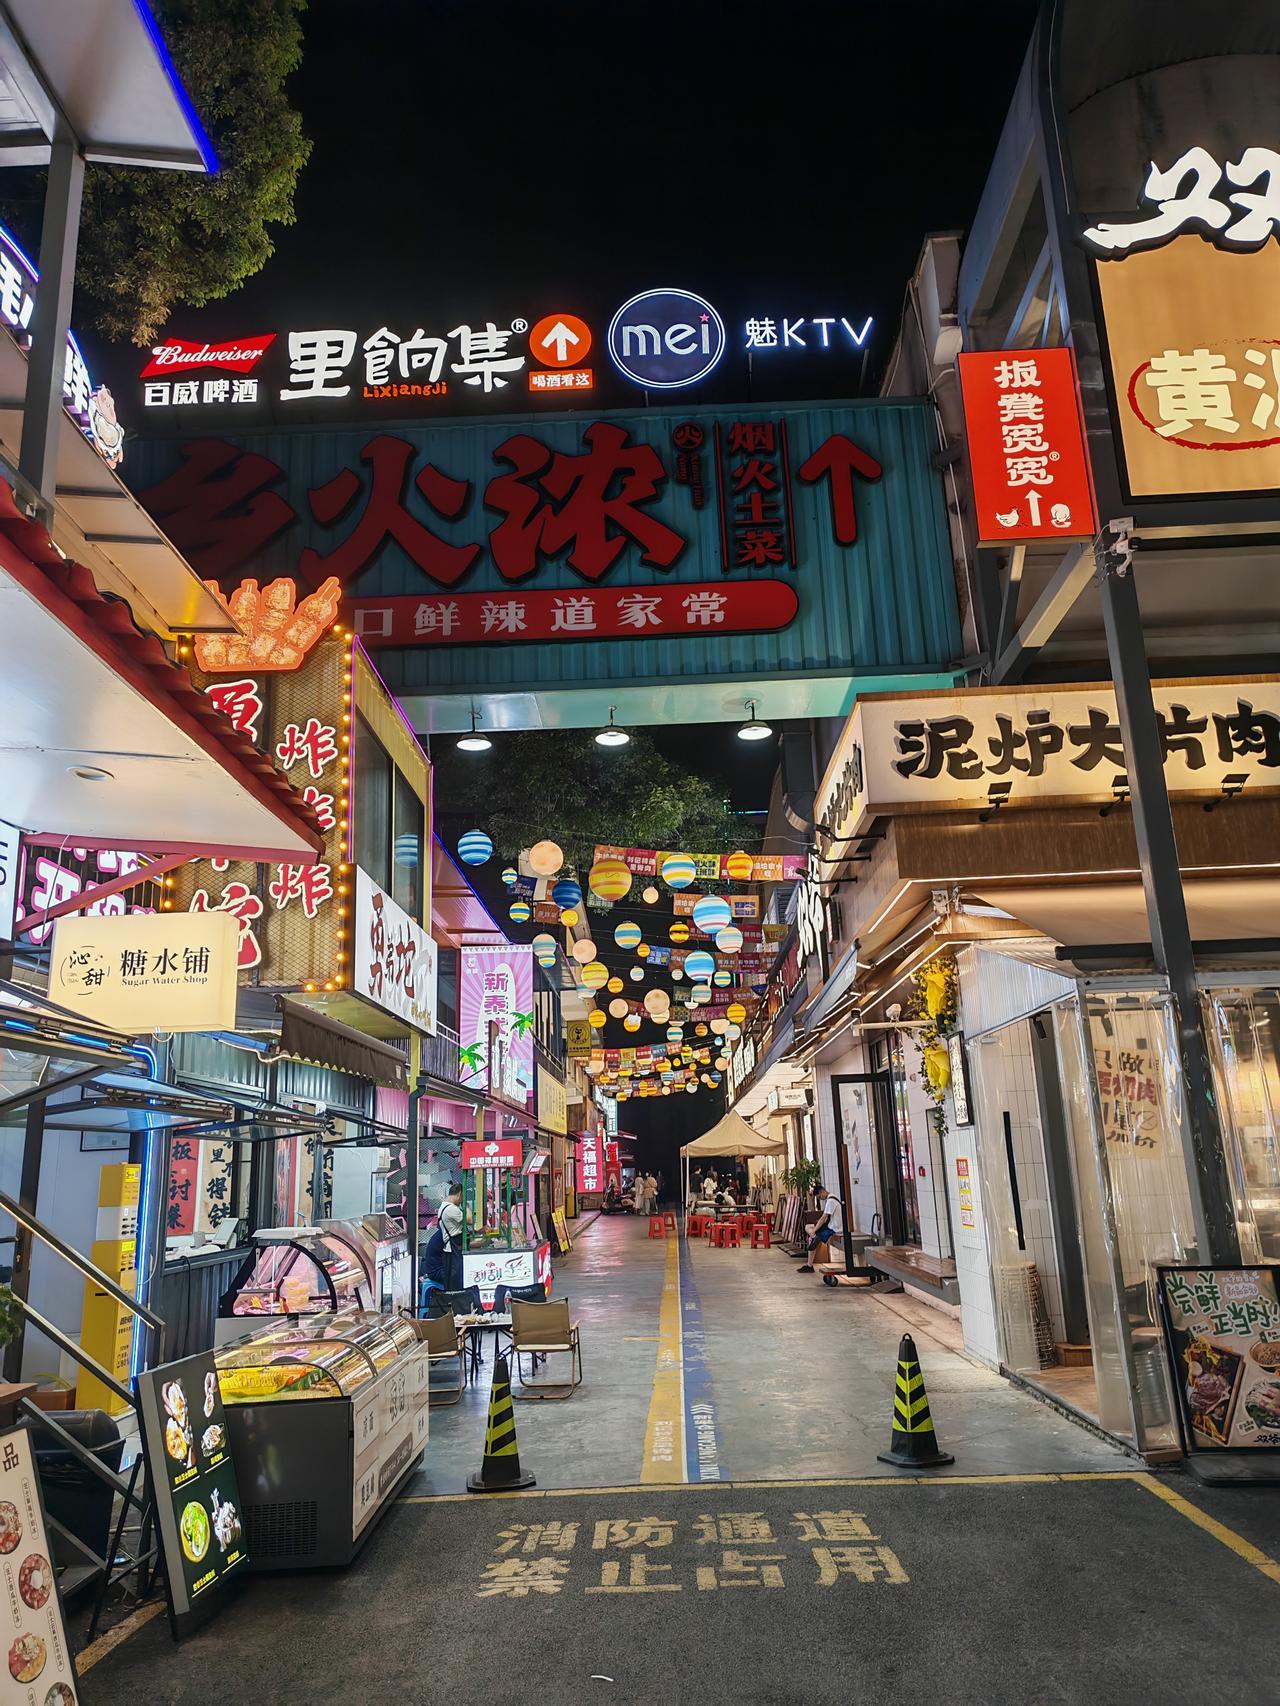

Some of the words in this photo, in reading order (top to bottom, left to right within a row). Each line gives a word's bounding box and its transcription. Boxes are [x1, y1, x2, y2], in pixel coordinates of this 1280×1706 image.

[621, 313, 711, 358] mei
[745, 315, 874, 349] 魅KTV
[152, 338, 264, 367] Budweiser
[143, 377, 259, 408] 百威啤酒
[363, 383, 448, 399] LiXiangJi
[532, 372, 590, 388] 喝酒看这
[728, 421, 785, 566] 烟火土菜
[892, 696, 1280, 780] 泥炉大片肉
[119, 946, 211, 978] 糖水铺
[121, 977, 150, 987] Sugar
[152, 976, 181, 985] Water
[181, 975, 209, 986] Shop
[582, 1137, 598, 1192] 天福超市
[2, 1441, 20, 1473] 品
[493, 1508, 882, 1554] 消防通道
[474, 1545, 911, 1598] 禁止占用
